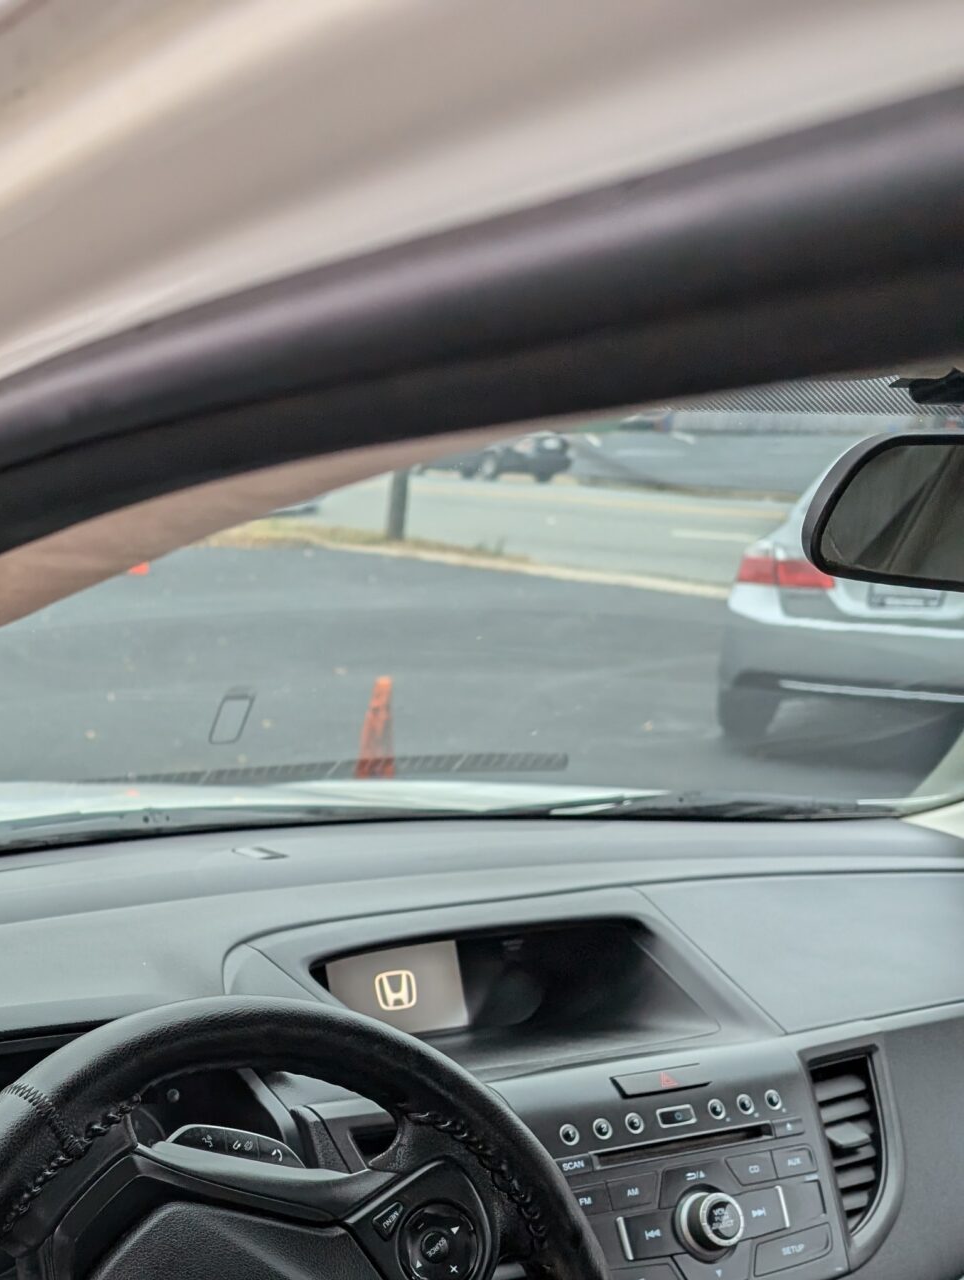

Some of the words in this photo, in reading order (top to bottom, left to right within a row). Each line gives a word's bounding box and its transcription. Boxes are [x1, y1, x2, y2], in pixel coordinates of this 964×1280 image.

[562, 1160, 585, 1171] SCAN
[578, 1196, 593, 1206] FM
[381, 1210, 400, 1229] MENU
[426, 1236, 447, 1258] SOURCE
